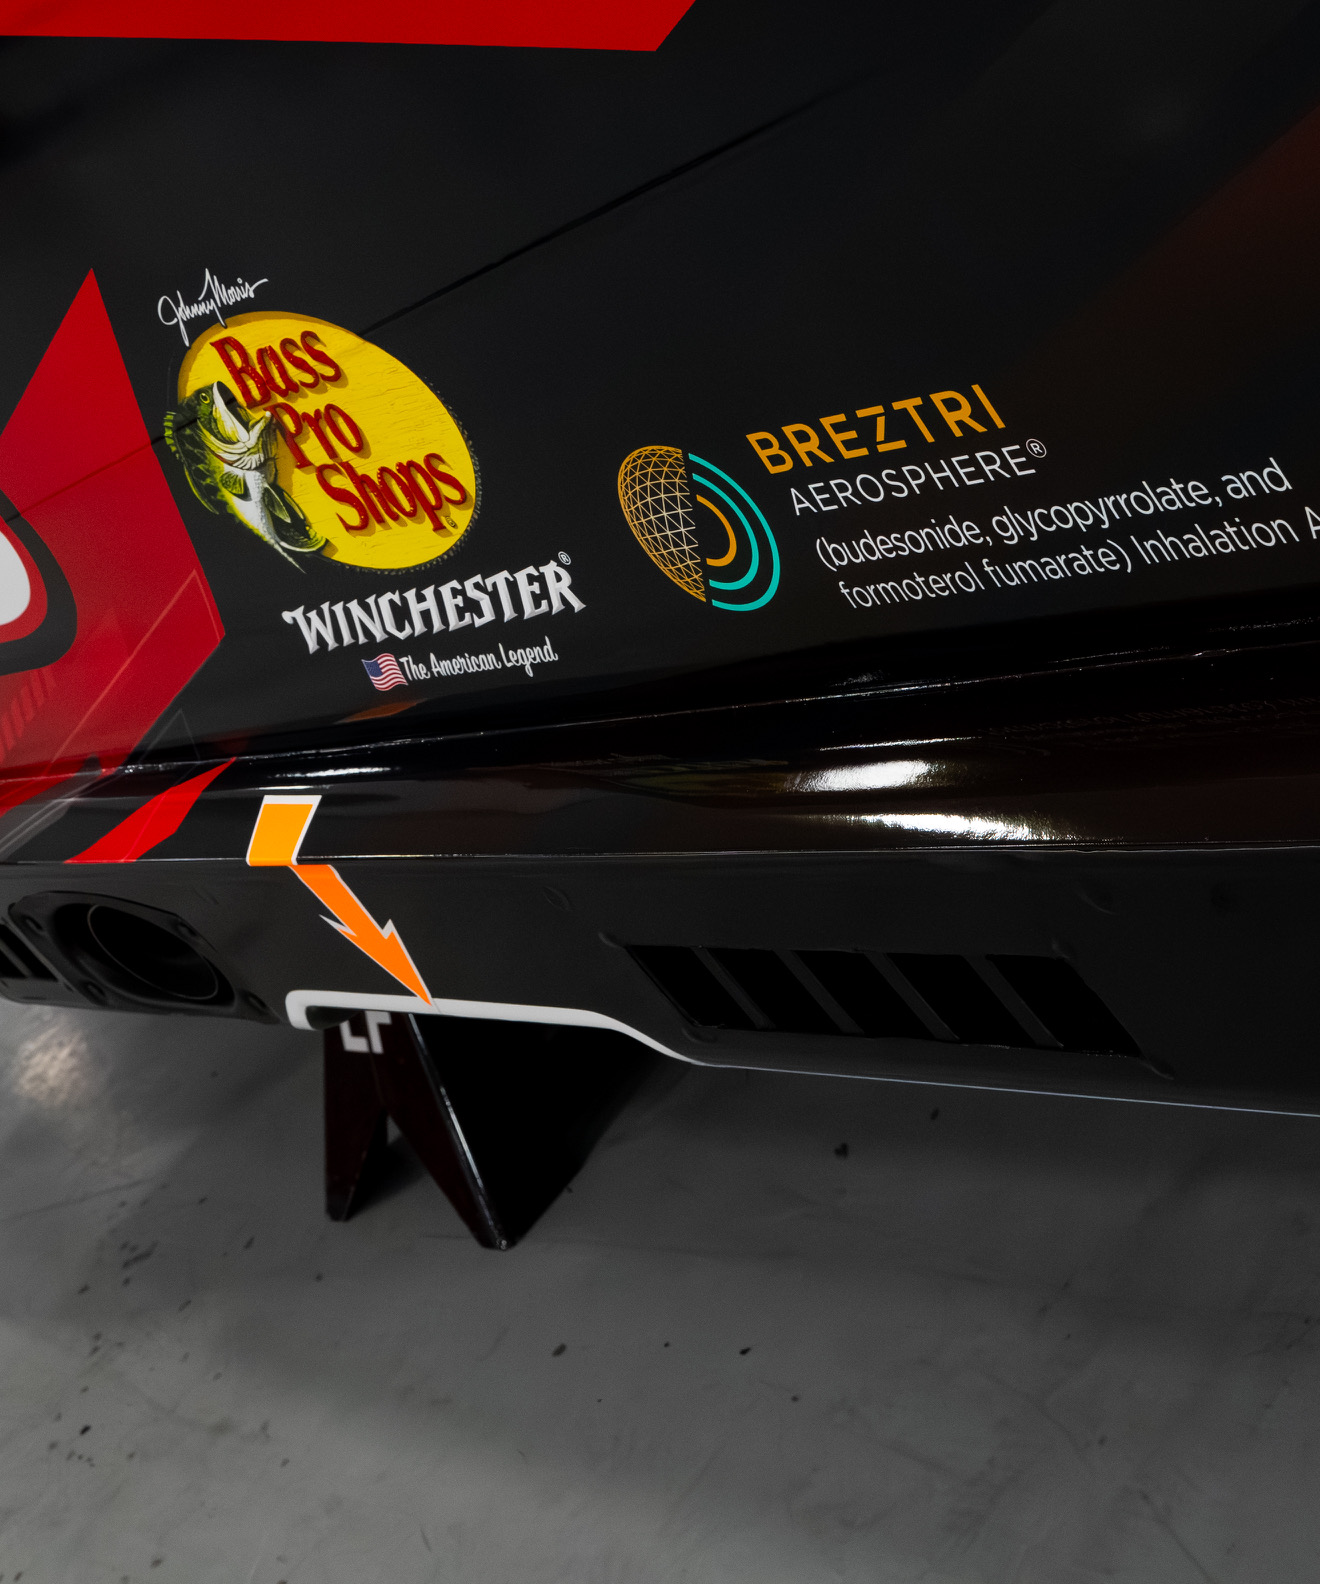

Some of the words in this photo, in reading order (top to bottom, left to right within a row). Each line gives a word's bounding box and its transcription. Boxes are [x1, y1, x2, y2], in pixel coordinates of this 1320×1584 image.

[210, 330, 343, 409] Bass
[263, 402, 364, 469] Pro
[746, 384, 1006, 474] BREZTRI
[316, 452, 468, 533] Shops
[816, 515, 993, 572] (budesonide,
[991, 478, 1223, 545] glycopyrrolate,
[1221, 457, 1293, 500] and
[839, 561, 985, 609] formoterol
[983, 539, 1132, 588] fumarate)
[1130, 517, 1300, 565] Inhalation
[398, 655, 430, 681] The
[430, 650, 502, 677] American
[498, 636, 559, 677] Legend
